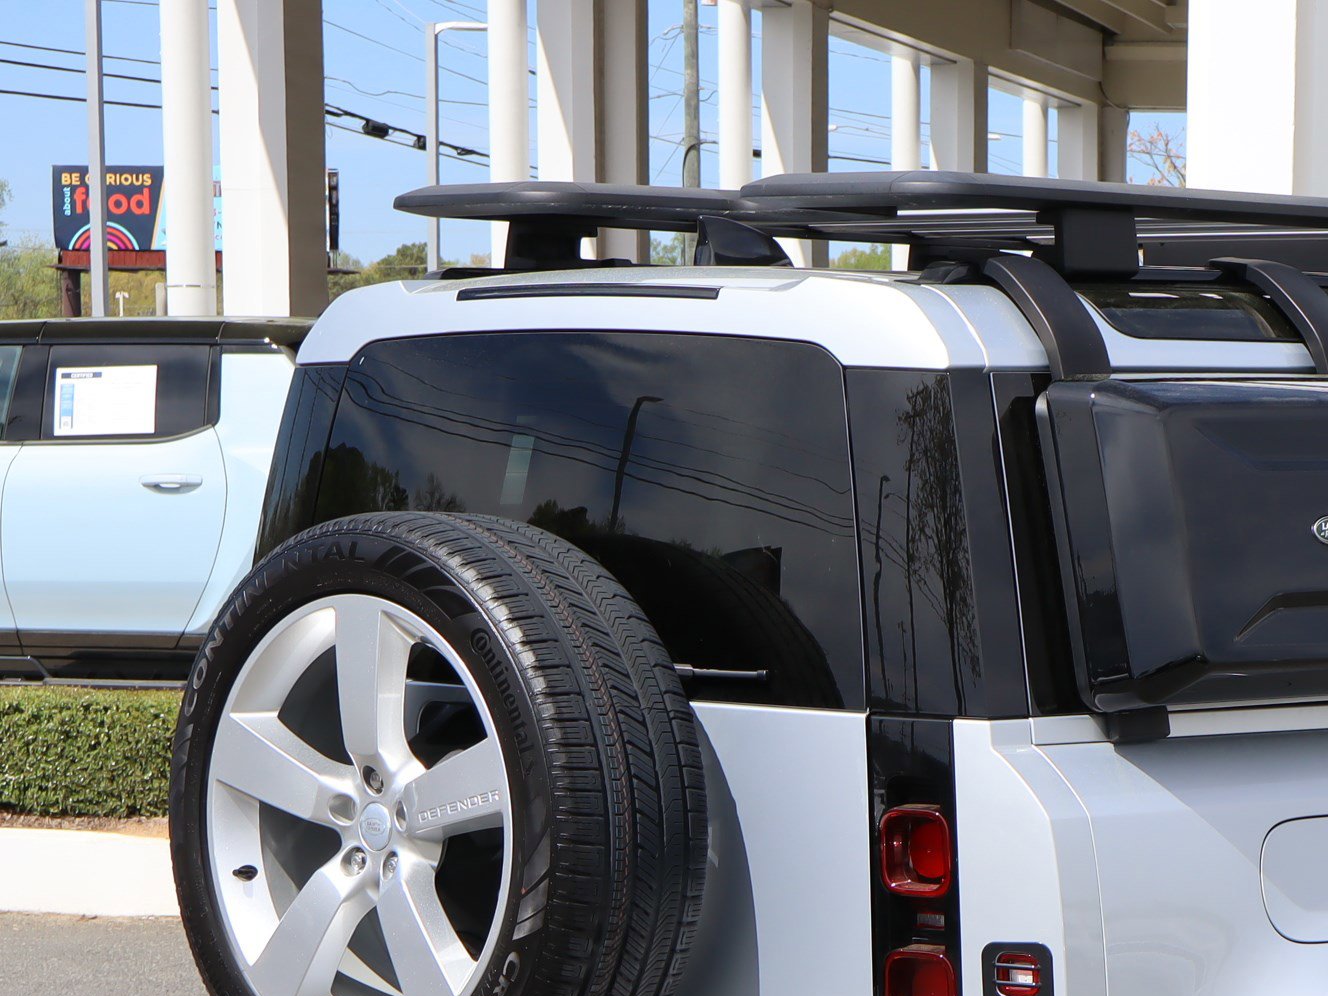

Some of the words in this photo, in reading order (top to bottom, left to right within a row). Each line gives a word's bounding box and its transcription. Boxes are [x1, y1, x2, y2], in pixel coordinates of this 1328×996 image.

[61, 172, 81, 186] BE
[85, 172, 153, 186] RIOUS
[62, 186, 71, 216] about
[74, 186, 152, 215] fod
[469, 627, 536, 756] Continental
[416, 787, 501, 823] DEFENDER
